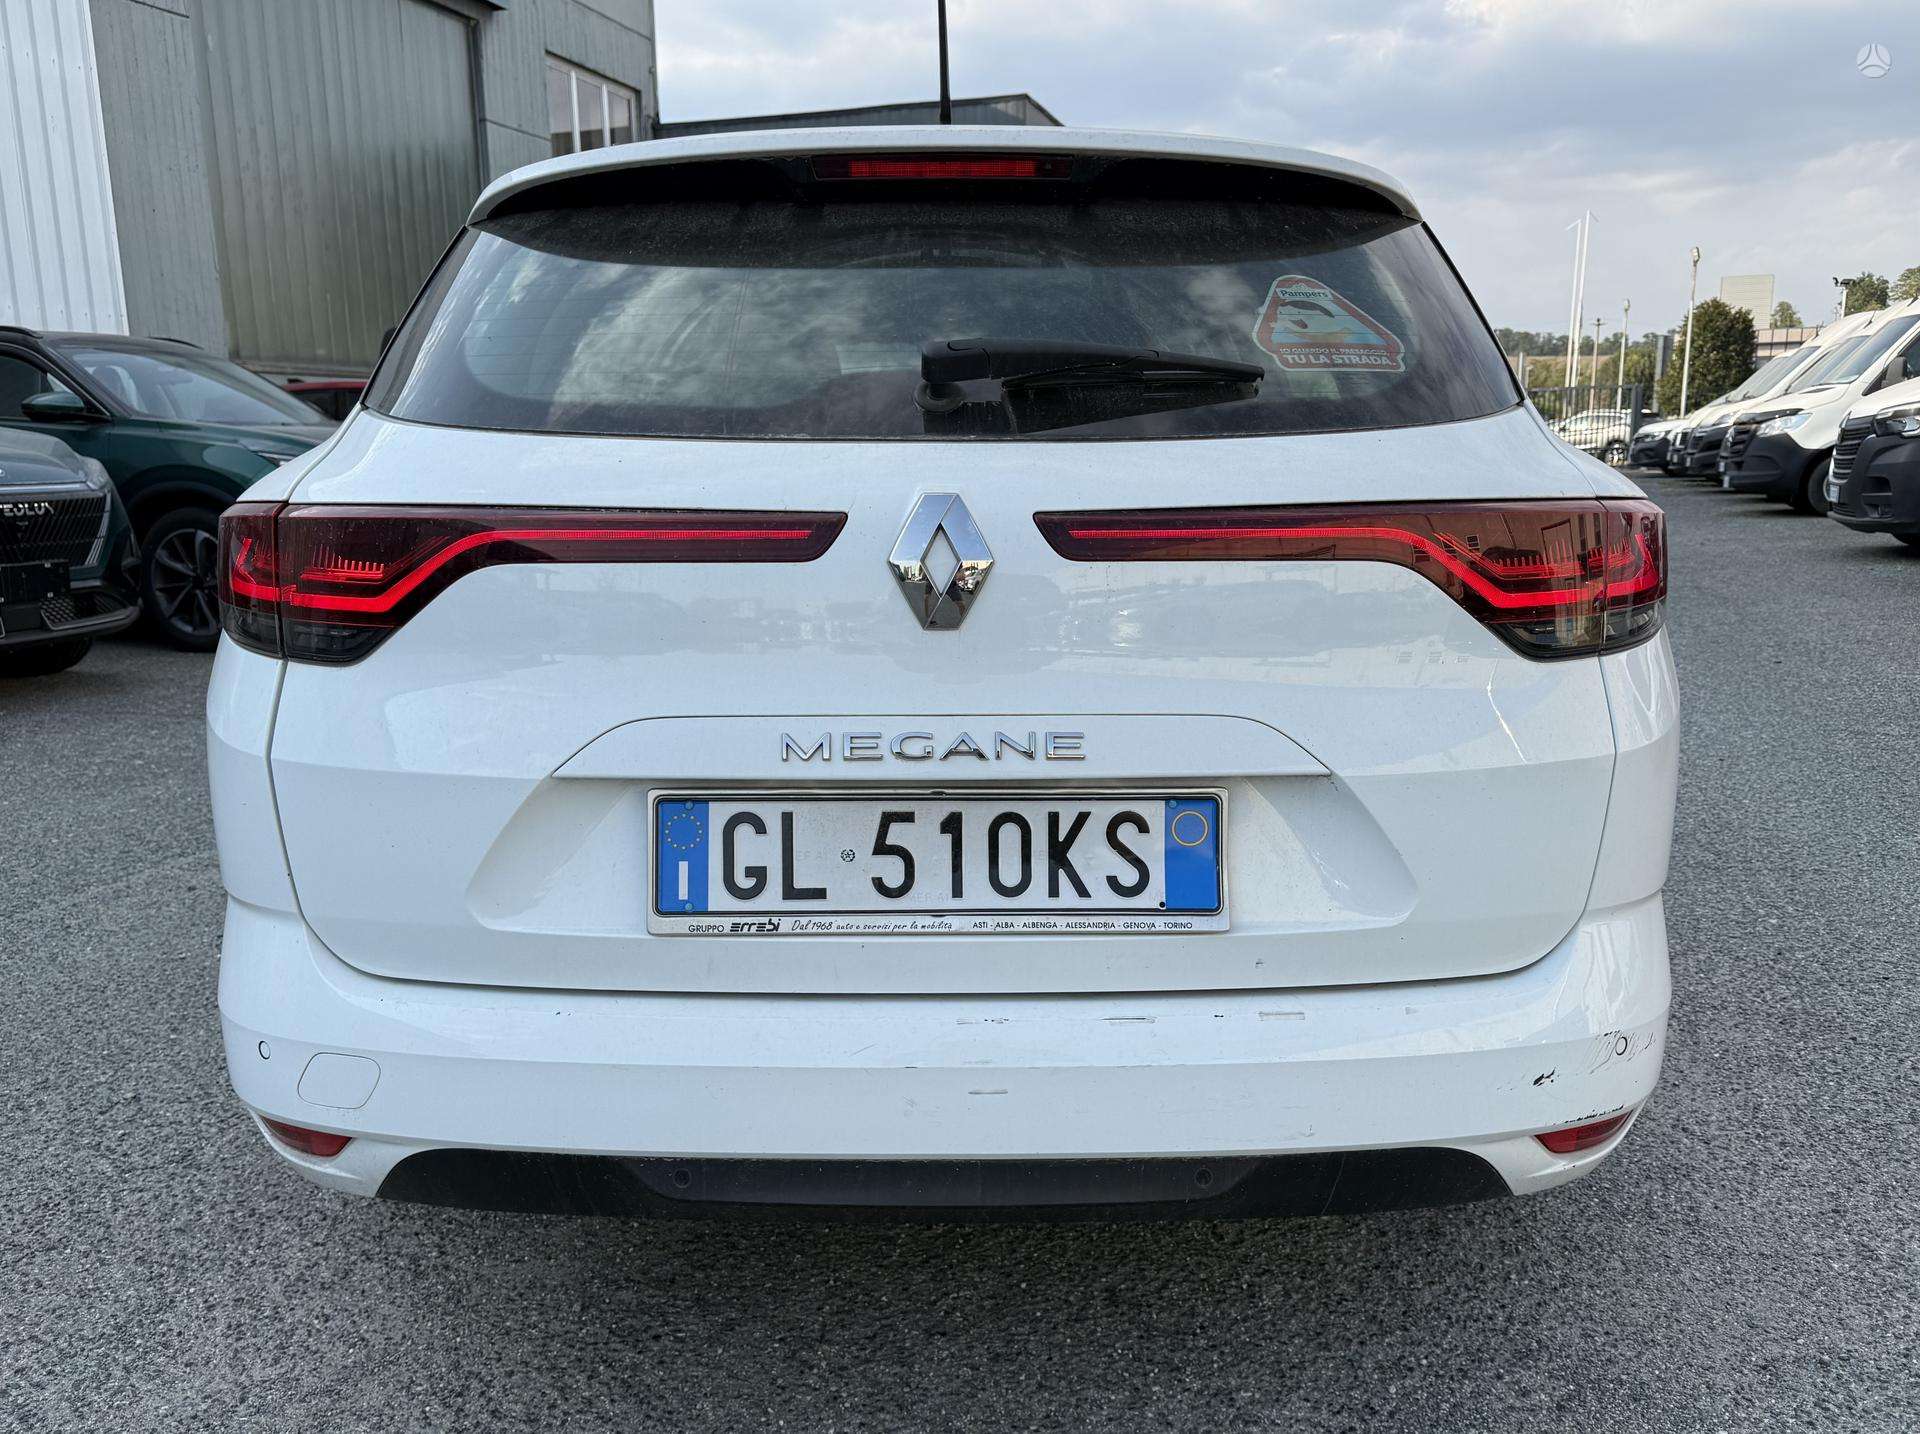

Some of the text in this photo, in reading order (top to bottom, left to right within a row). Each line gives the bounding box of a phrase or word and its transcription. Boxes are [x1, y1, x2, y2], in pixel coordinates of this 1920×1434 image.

[1279, 289, 1329, 298] Pampers
[1283, 354, 1397, 366] TU LA STRADA.
[781, 730, 1086, 762] MEGANE
[722, 811, 1152, 901] GL 510KS
[688, 923, 725, 933] GRUPPO
[791, 919, 810, 931] Dal
[811, 920, 833, 931] 1968
[836, 922, 854, 930] auto
[863, 922, 892, 930] servizi
[892, 923, 907, 932] per
[909, 920, 919, 930] la
[921, 920, 953, 931] mobilità
[972, 921, 988, 929] ASTI
[995, 921, 1015, 929] ALBA
[1021, 921, 1058, 929] ALBENGA
[1065, 921, 1116, 929] ALESSANDRIA
[1122, 921, 1157, 929] GENOVA
[1163, 921, 1193, 929] TORINO
